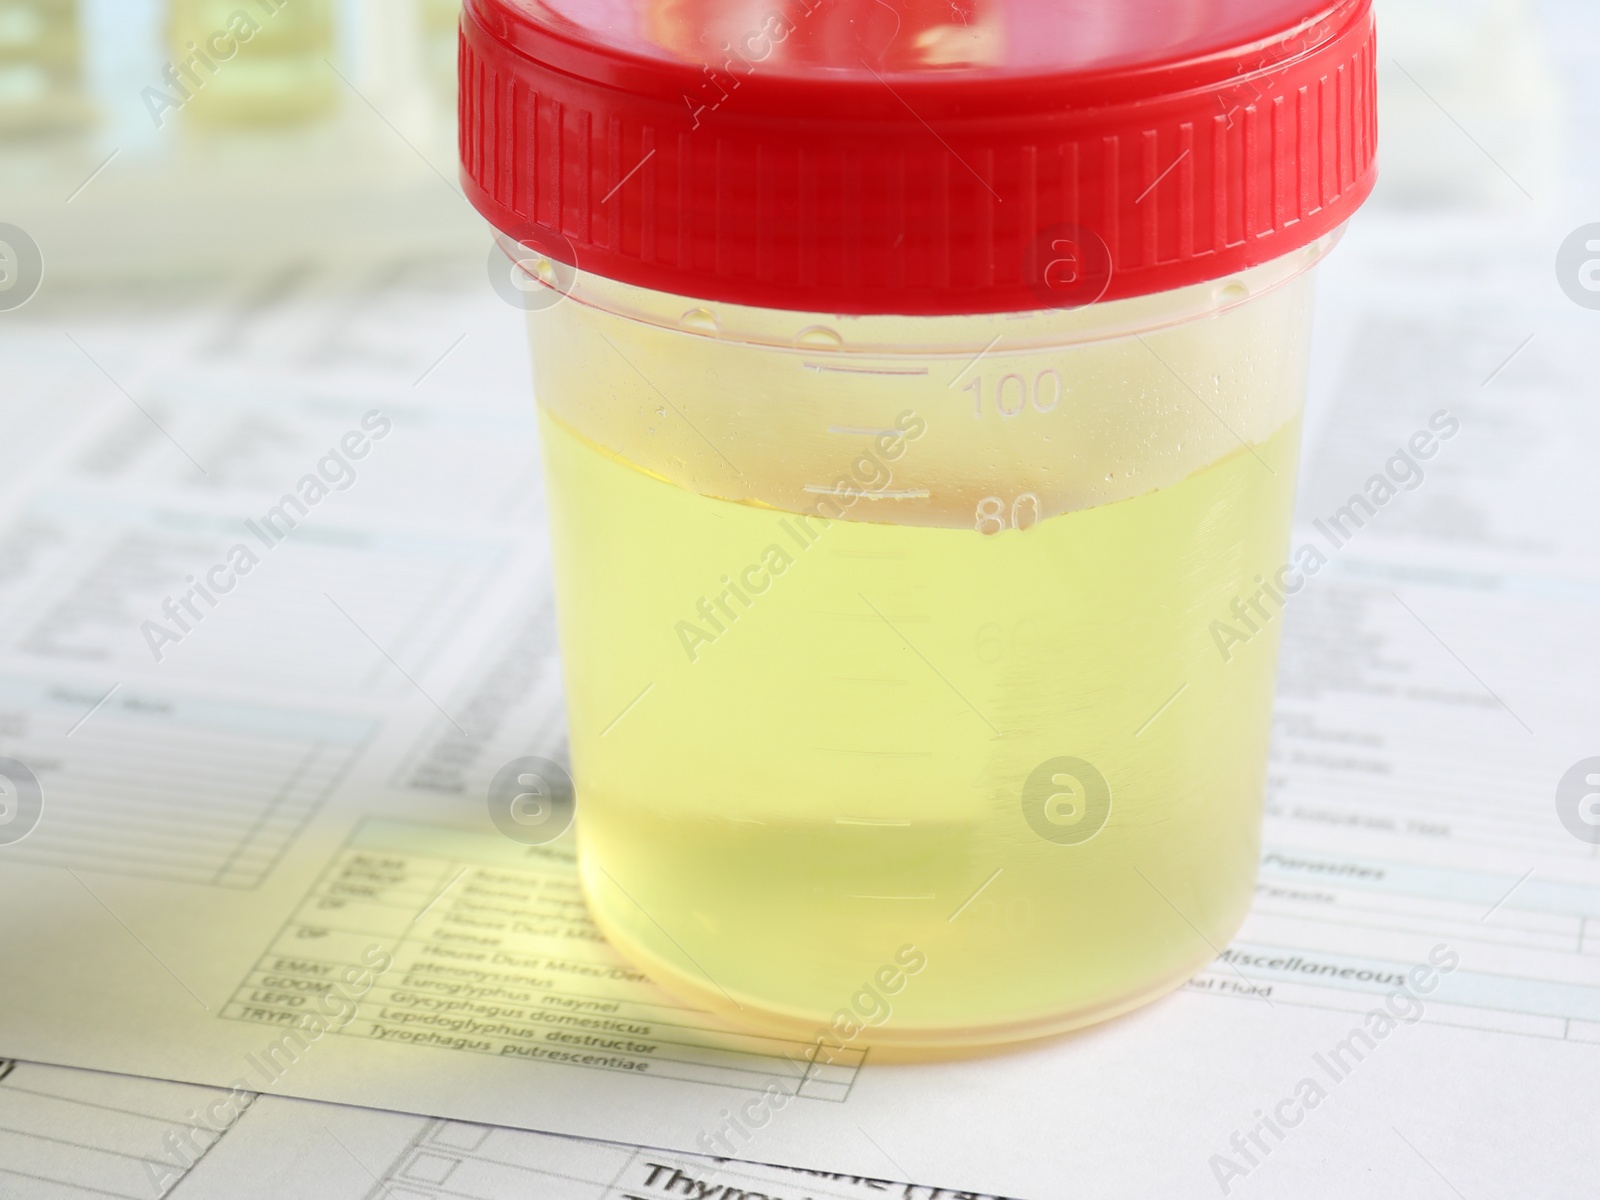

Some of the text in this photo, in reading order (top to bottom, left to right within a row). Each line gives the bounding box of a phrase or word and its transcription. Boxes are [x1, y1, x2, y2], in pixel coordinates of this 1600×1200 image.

[962, 368, 1062, 419] 100
[974, 492, 1042, 536] 80
[402, 975, 620, 1014] Euroglyphus maynei
[1220, 981, 1273, 998] Fluid
[378, 1007, 658, 1054] Lepidoglyphus destructor
[390, 991, 651, 1035] Glycyphagus domesticus
[369, 1023, 650, 1073] Tyrophagus putrescentiae
